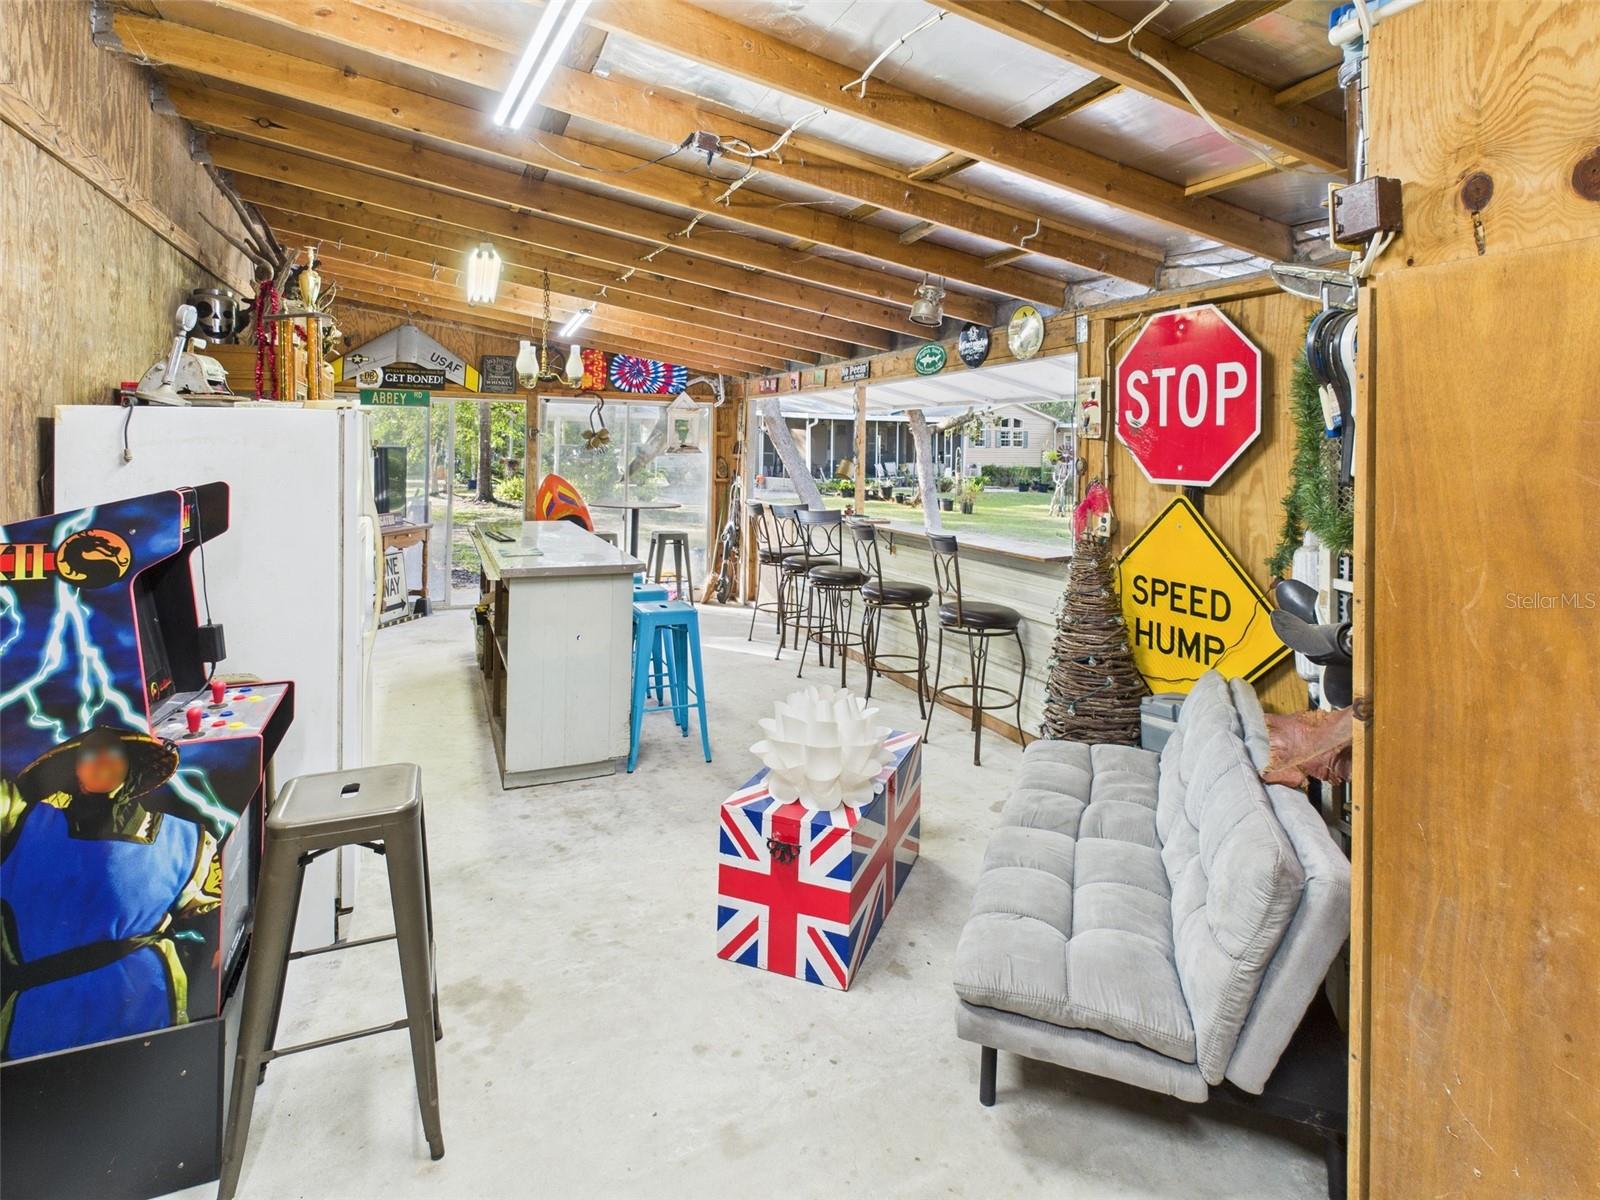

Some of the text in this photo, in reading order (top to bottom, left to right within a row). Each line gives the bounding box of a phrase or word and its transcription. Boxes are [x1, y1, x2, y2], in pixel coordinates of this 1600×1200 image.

[430, 352, 462, 374] USAF
[385, 373, 444, 385] GET BONED!
[371, 391, 423, 405] ABBEY RD
[1125, 362, 1248, 428] STOP
[385, 557, 400, 576] NE
[1132, 574, 1232, 622] SPEED
[1135, 617, 1226, 666] HUMP
